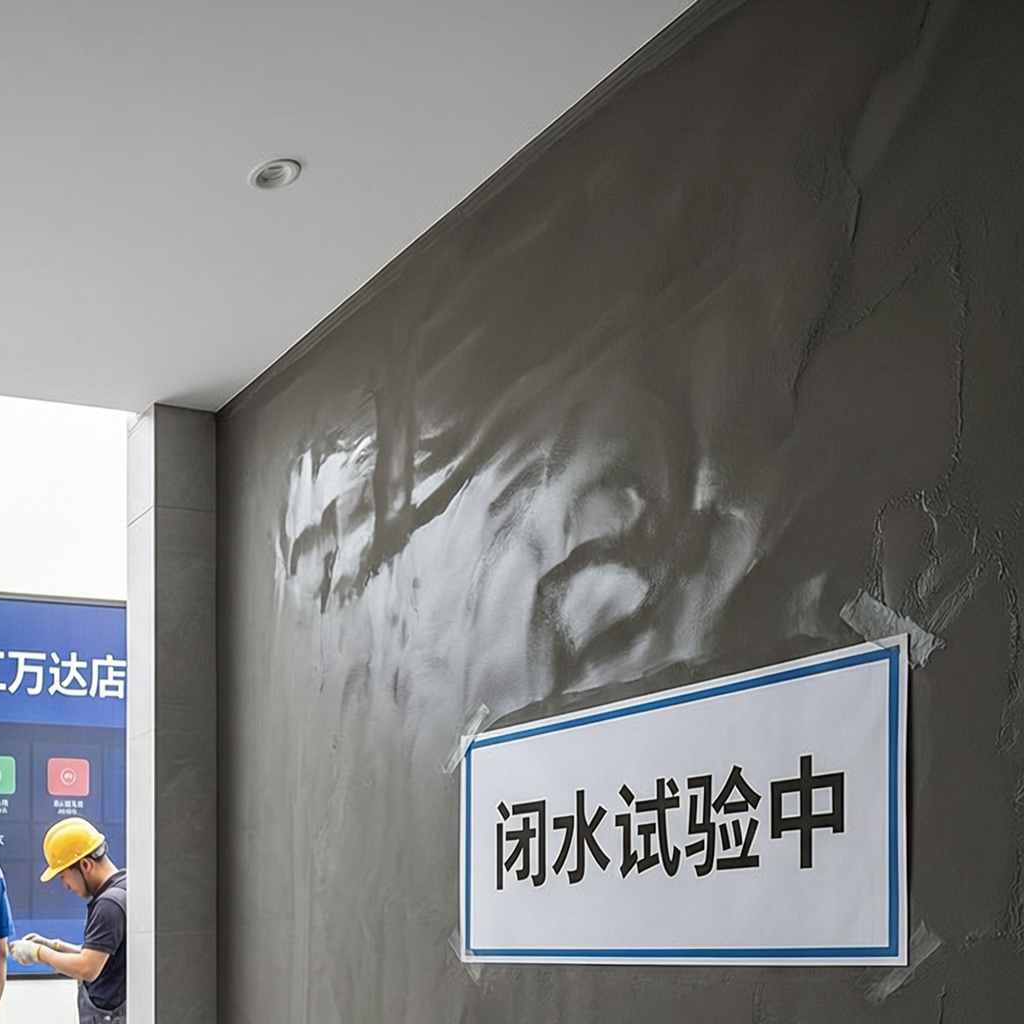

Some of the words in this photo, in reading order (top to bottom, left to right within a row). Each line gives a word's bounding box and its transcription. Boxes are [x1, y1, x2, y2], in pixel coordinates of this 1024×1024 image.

[495, 755, 845, 890] 闭水试验中
